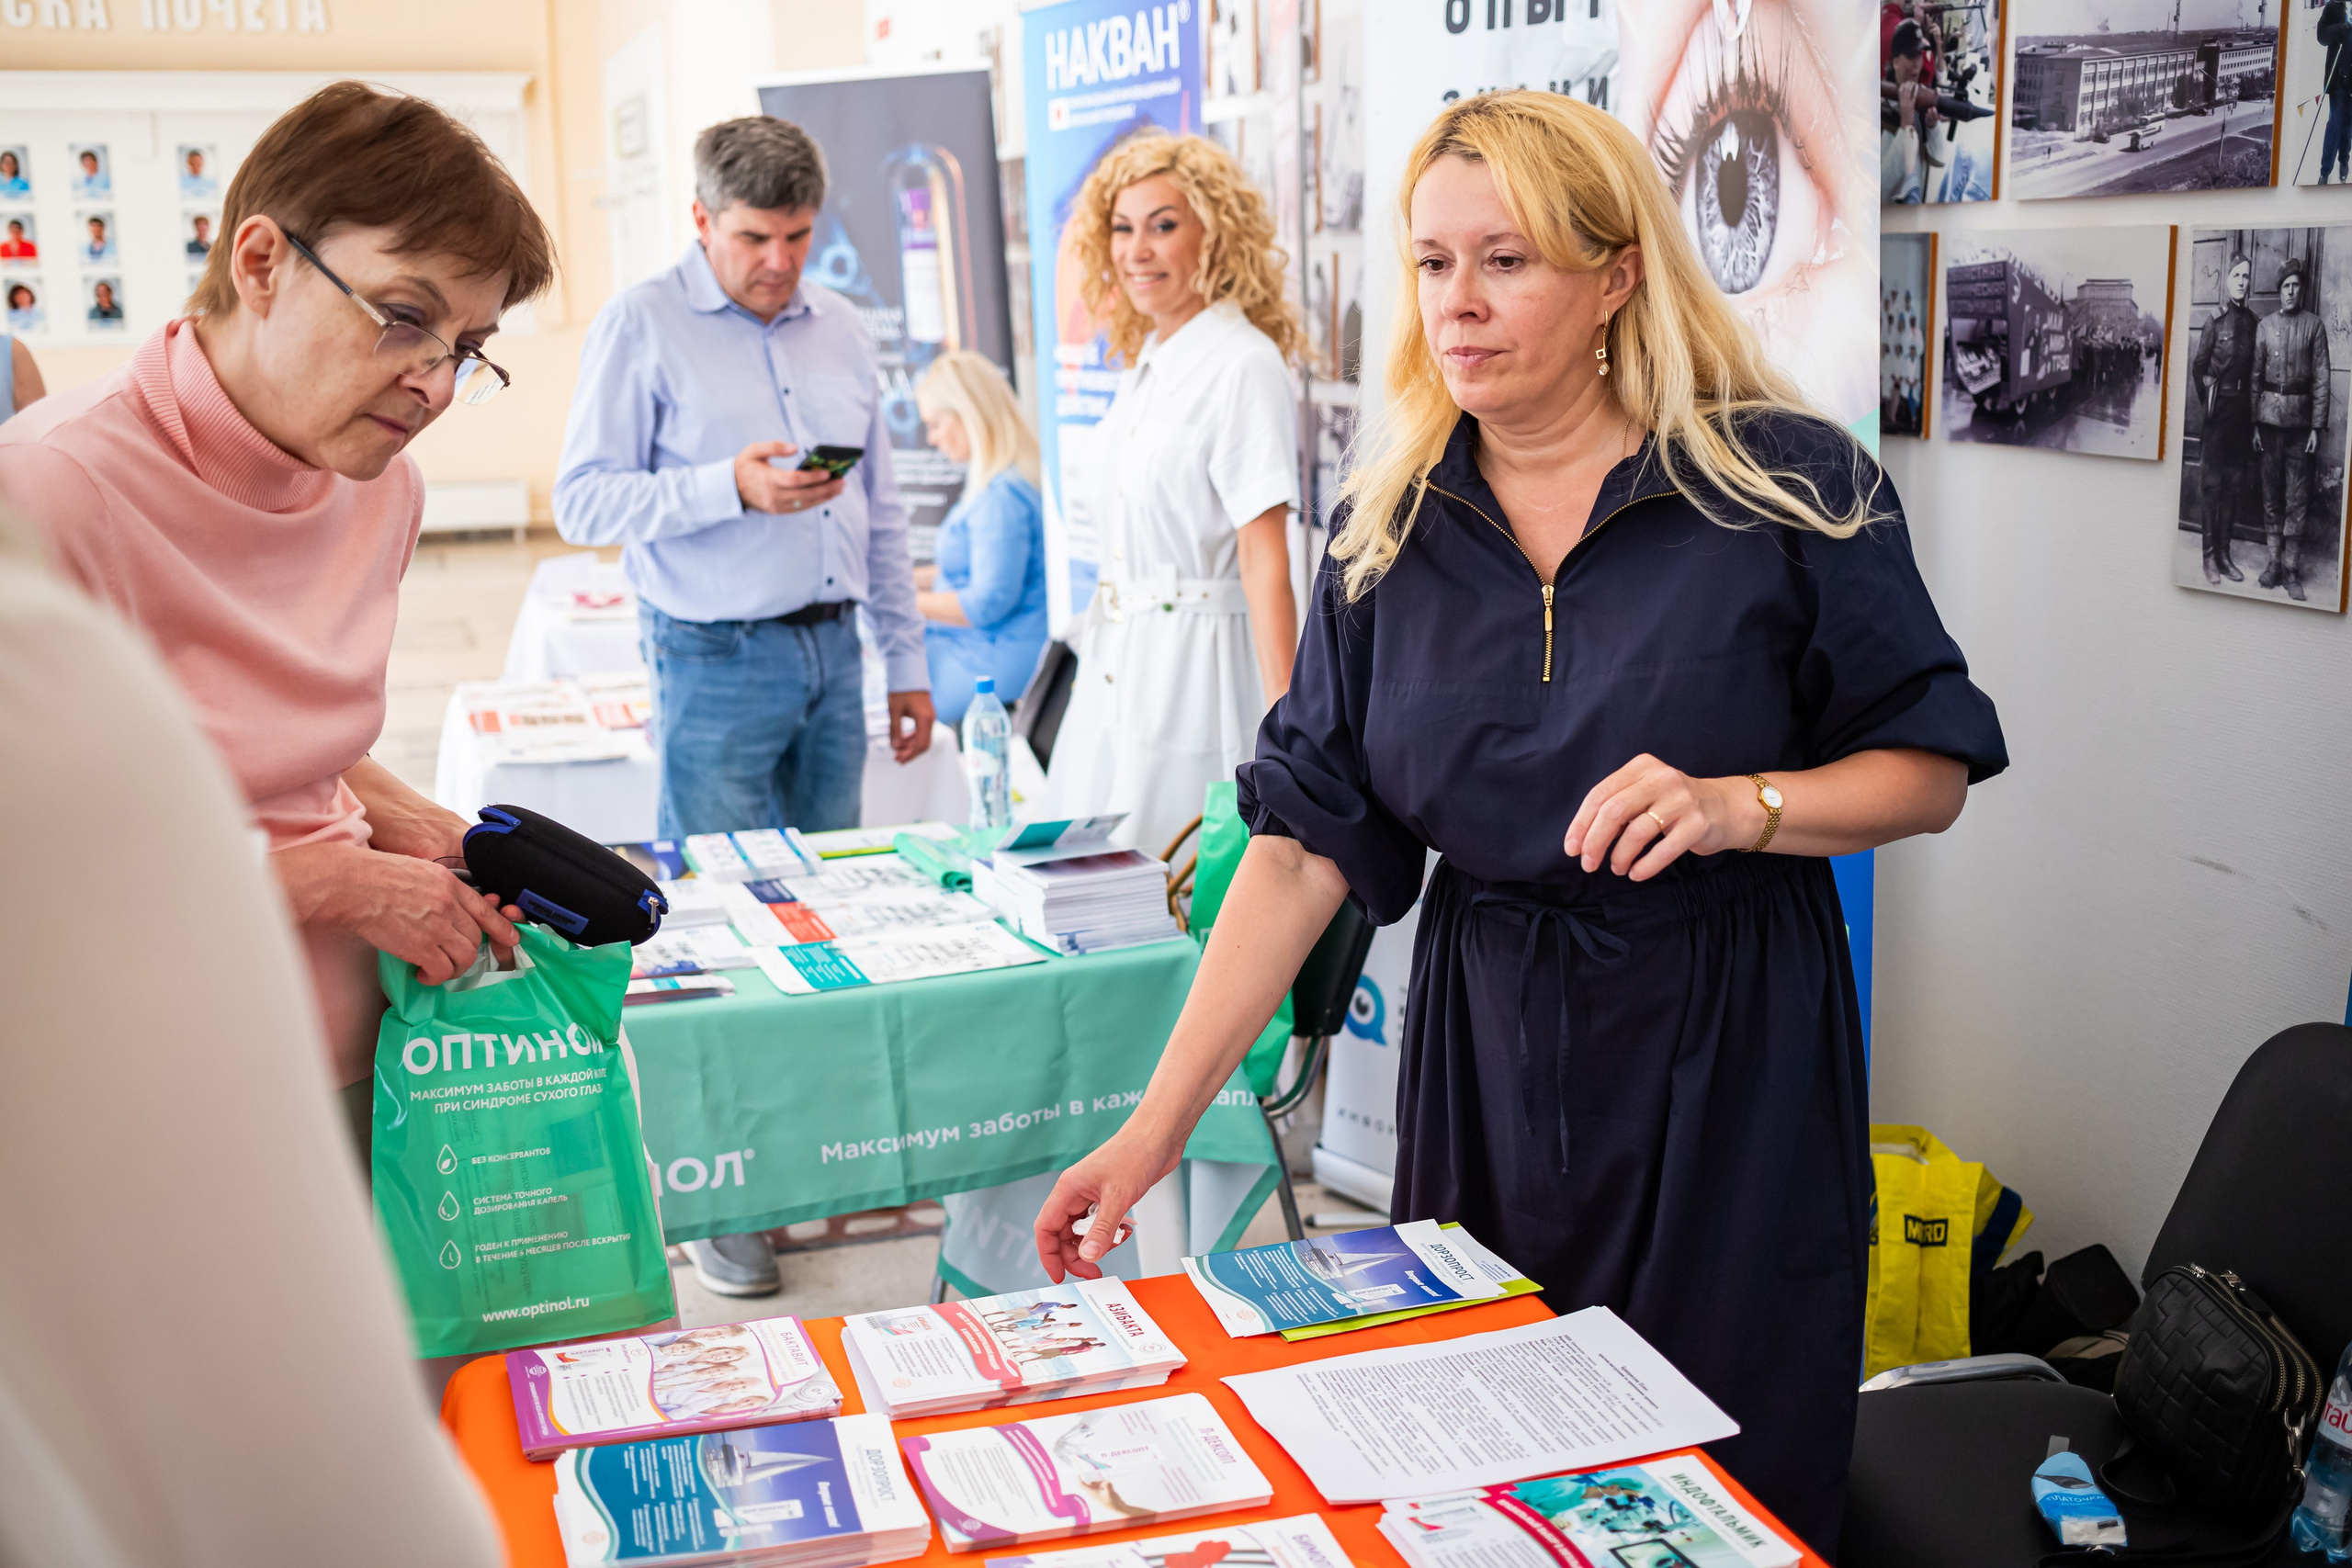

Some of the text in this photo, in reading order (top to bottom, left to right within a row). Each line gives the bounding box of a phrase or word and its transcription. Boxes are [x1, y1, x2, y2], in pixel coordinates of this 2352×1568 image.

[410, 1084, 484, 1101] МАКСИМУМ
[486, 1077, 534, 1094] ЗАБОТЫ
[537, 1077, 543, 1087] В
[545, 1067, 594, 1087] КАЖДОЙ
[435, 1101, 460, 1114] ПРИ
[462, 1094, 531, 1111] СИНДРОМЕ
[533, 1087, 577, 1102] СУХОГО
[820, 1124, 960, 1165] Максимум
[968, 1105, 1061, 1139] заботы
[1069, 1100, 1085, 1116] в
[471, 1147, 551, 1165] БЕЗ КОНСЕРВАНТОВ
[473, 1187, 552, 1205] СИСТЕМА ТОЧНОГО
[473, 1194, 568, 1215] ДОЗИРОВАНИЯ КАПЕЛЬ
[475, 1241, 503, 1252] ГОДЕН
[511, 1231, 569, 1247] ПРИМЕНЕНИЮ
[475, 1256, 481, 1264] В
[482, 1251, 518, 1263] ТЕЧЕНИЕ
[526, 1244, 561, 1256] МЕСЯЦЕВ
[562, 1239, 590, 1250] ПОСЛЕ
[1428, 1243, 1476, 1281] ДОРЗОПРОСТ
[481, 1296, 590, 1323] www.optinol.ru
[1104, 1302, 1146, 1337] АЗИБАКТА
[779, 1331, 808, 1366] БАКТАВИТ
[1196, 1427, 1238, 1464] Л-ДЕКСОПТ
[862, 1447, 899, 1501] ДОРЗОПРОСТ
[1669, 1472, 1766, 1551] ИНДОФТАЛЬМИК
